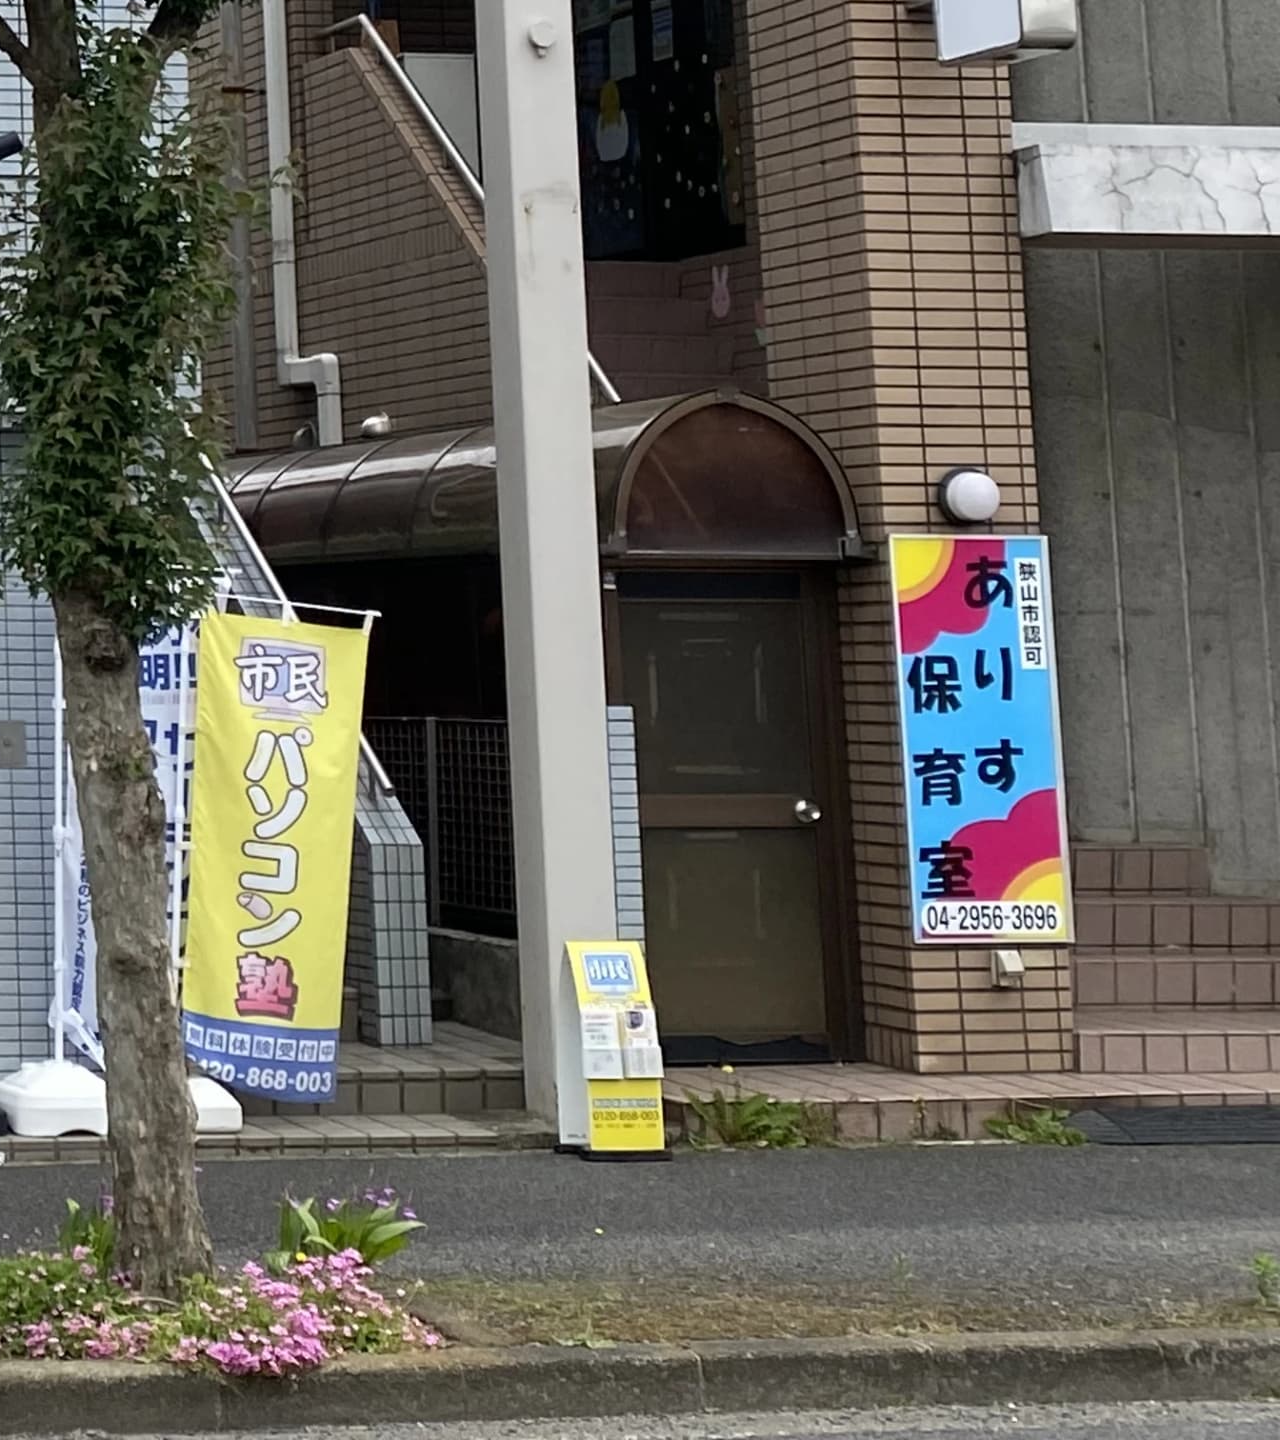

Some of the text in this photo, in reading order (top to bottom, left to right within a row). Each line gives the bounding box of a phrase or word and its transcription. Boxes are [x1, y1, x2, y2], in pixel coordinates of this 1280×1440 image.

[1018, 562, 1042, 666] 狭山市認可
[234, 644, 328, 709] 市民
[964, 555, 1024, 794] ありす
[907, 655, 976, 901] 保育室
[236, 727, 315, 1021] パソコン塾
[926, 904, 1058, 931] 04-2956-3696
[187, 1054, 333, 1092] 20-868-003
